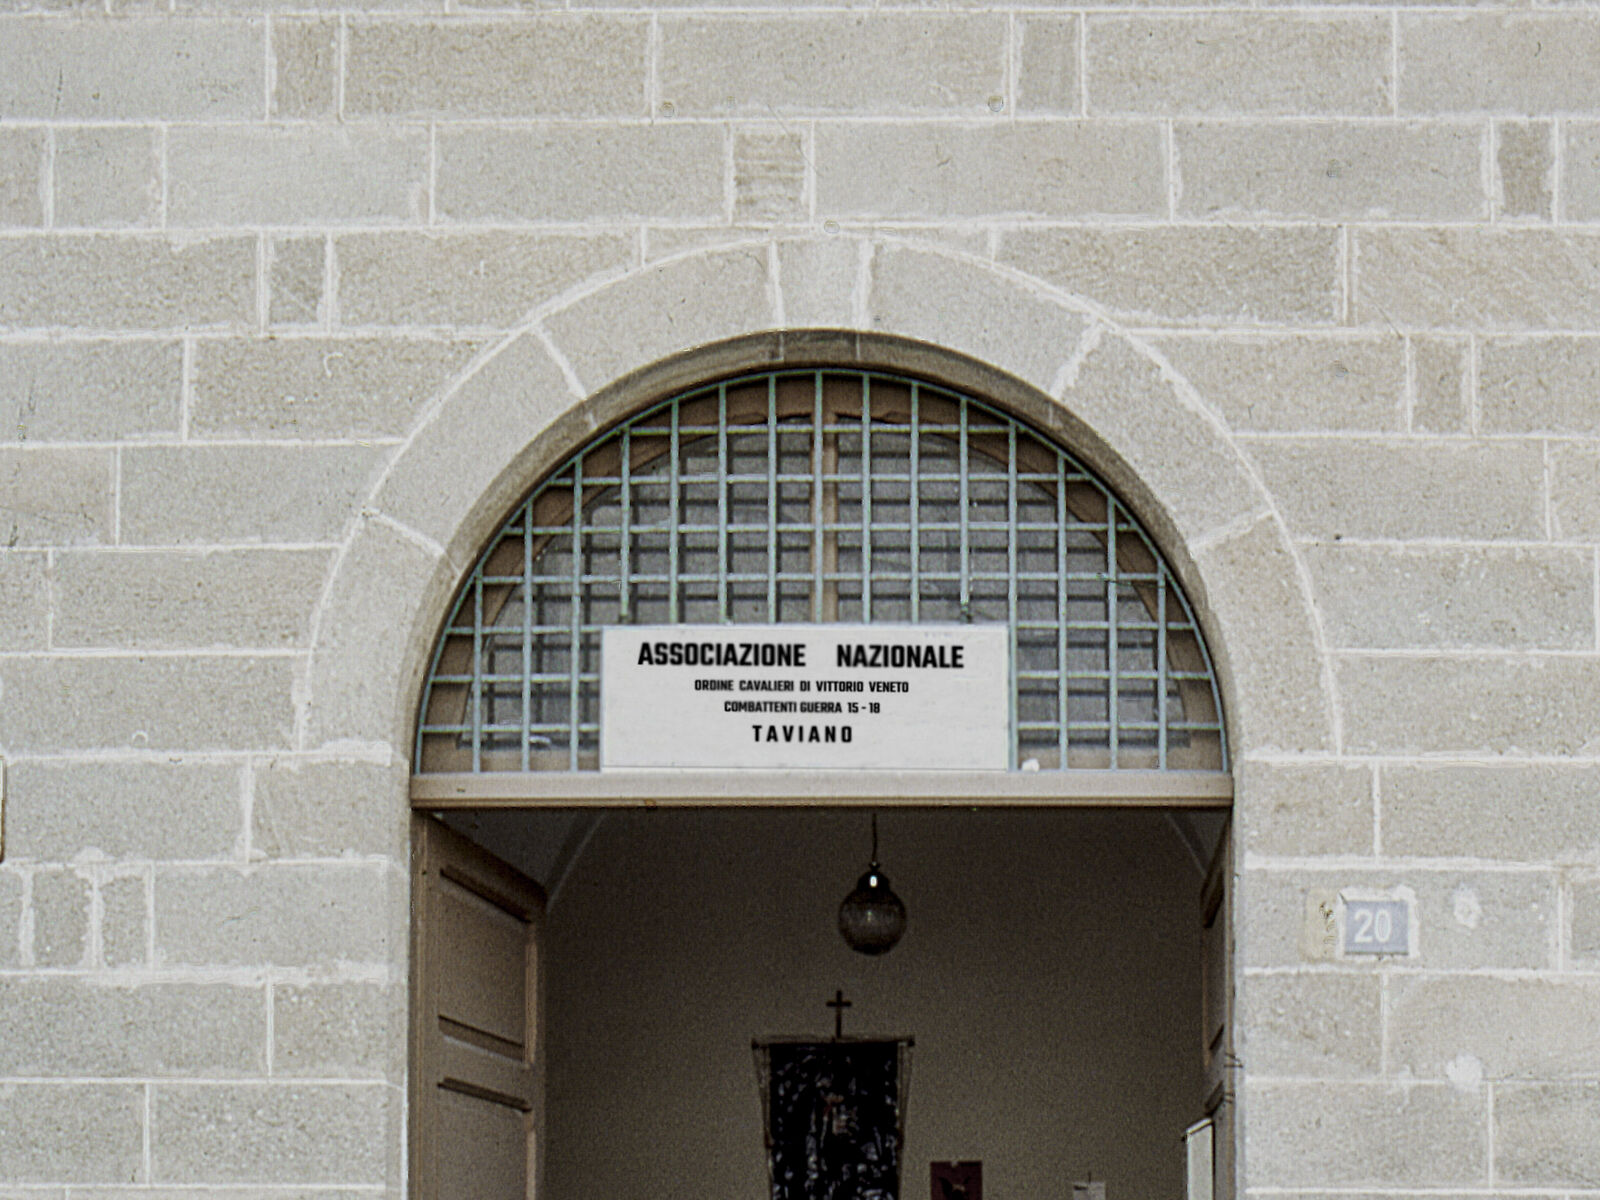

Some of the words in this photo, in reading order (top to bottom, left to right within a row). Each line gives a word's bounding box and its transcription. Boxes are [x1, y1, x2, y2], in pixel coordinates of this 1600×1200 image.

[637, 641, 807, 668] ASSOCIAZIONE
[836, 643, 965, 669] NAZIONALE
[694, 679, 734, 692] ORDINE
[738, 679, 795, 692] CAVALIERI
[799, 680, 811, 692] DI
[815, 680, 864, 693] VITTORIO
[868, 680, 909, 693] VENETO
[723, 700, 797, 713] COMBATTENTI
[799, 701, 843, 714] GUERRA
[847, 701, 859, 714] 15
[868, 702, 881, 714] 18
[752, 724, 853, 744] TAVIANO
[1353, 908, 1392, 943] 20
